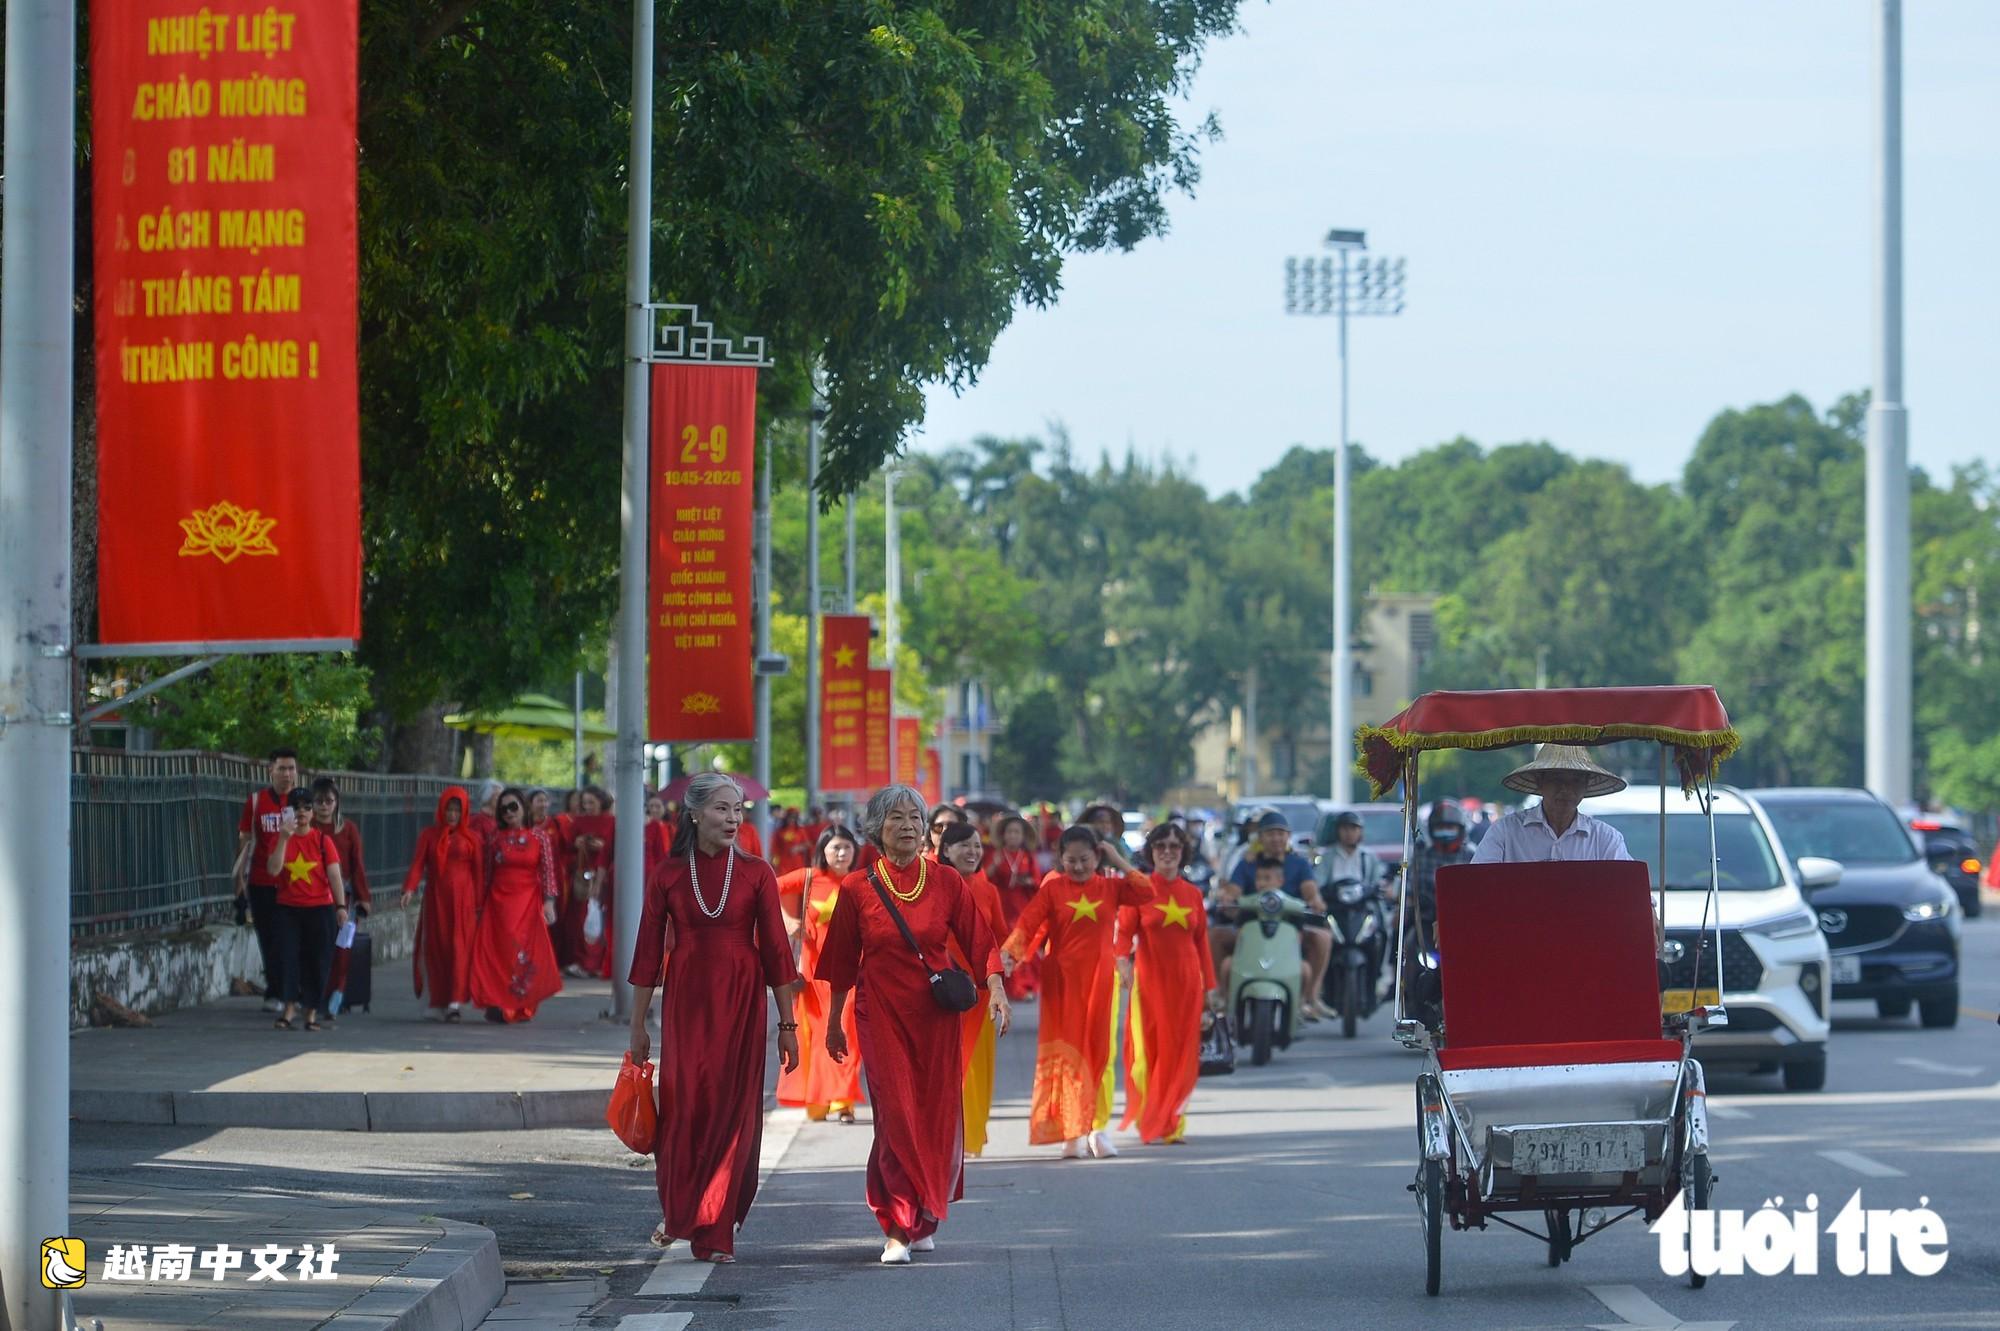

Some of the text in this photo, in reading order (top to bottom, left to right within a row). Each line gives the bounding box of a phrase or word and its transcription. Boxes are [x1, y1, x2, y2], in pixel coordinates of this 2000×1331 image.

[148, 6, 295, 60] NHIỆT LIỆT
[135, 71, 306, 120] CHÀO MỪNG
[167, 146, 197, 184] 81
[207, 137, 275, 183] NĂM
[137, 205, 210, 251] CÁCH
[218, 208, 304, 255] MẠNG
[142, 268, 232, 317] THÁNG
[240, 267, 300, 313] TÁM
[126, 337, 214, 383] THÀNH
[680, 424, 728, 464] 2-9
